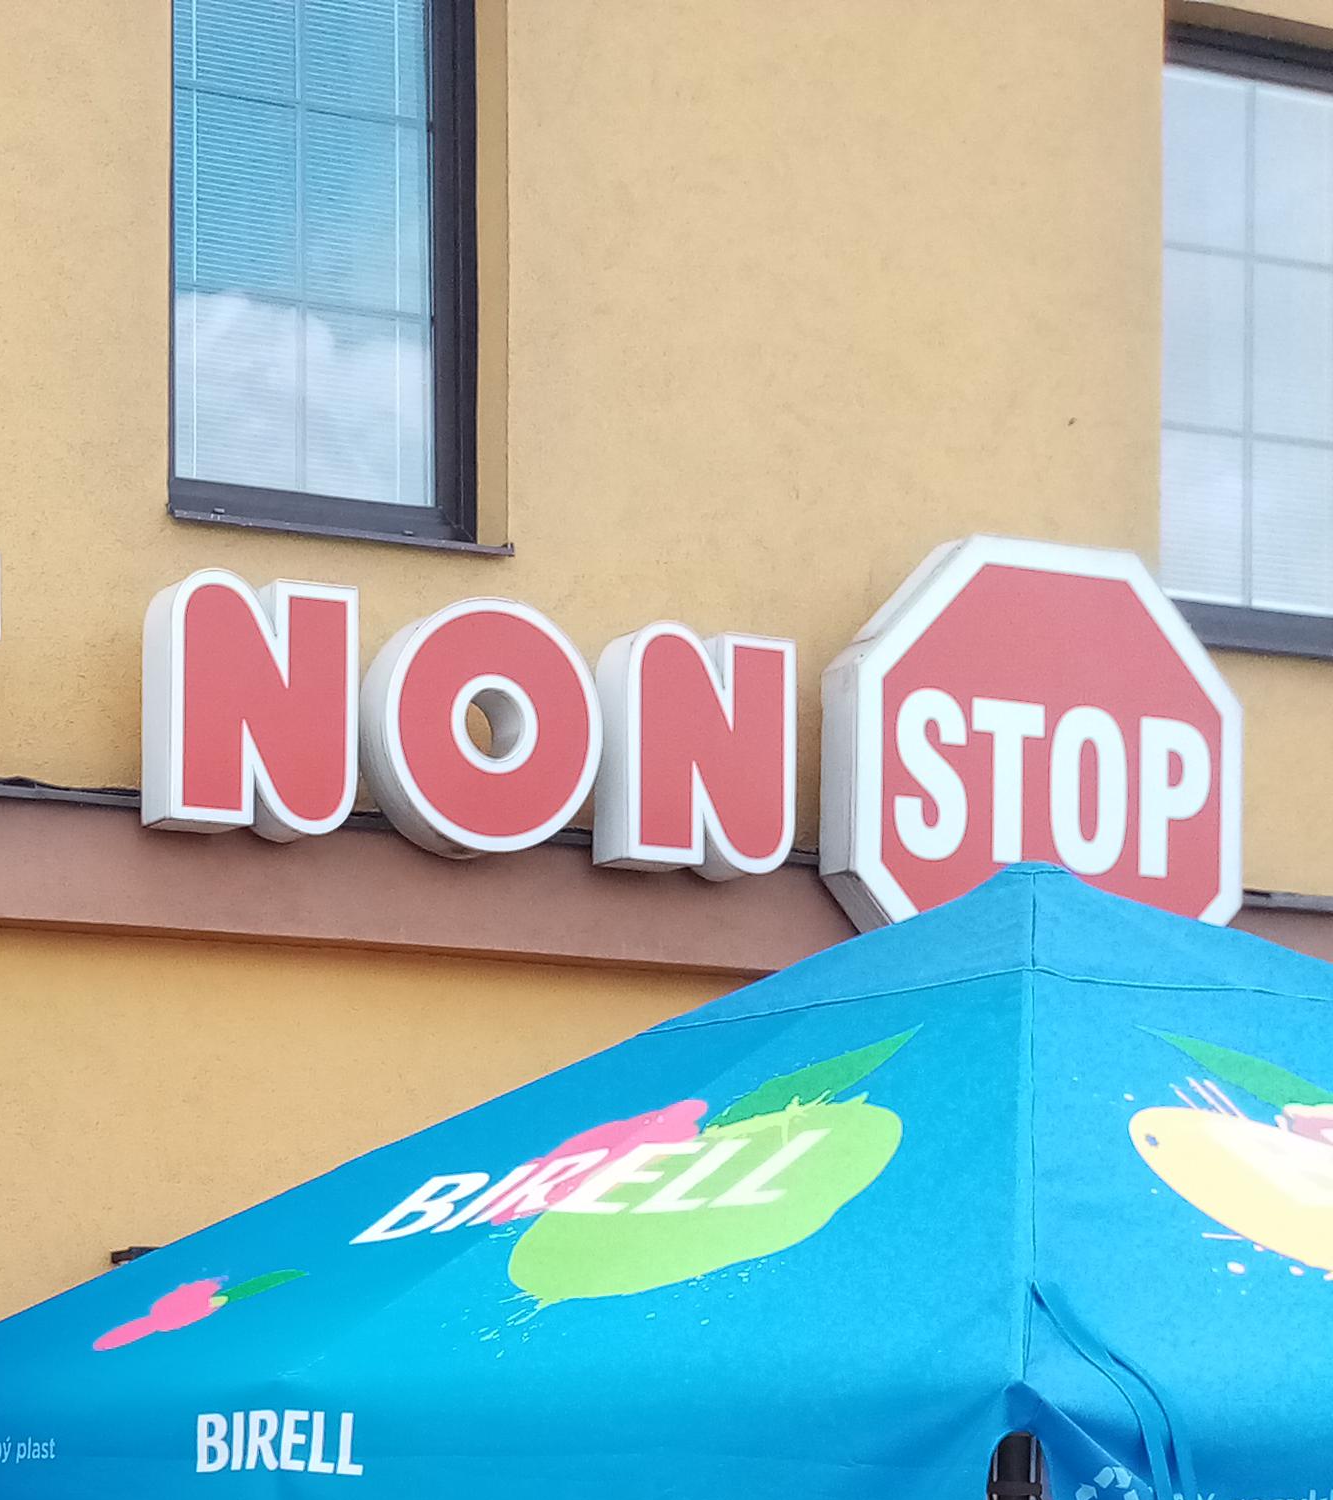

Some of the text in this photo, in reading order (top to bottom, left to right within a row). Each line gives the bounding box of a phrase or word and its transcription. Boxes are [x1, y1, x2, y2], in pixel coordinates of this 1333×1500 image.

[142, 567, 798, 882] NON
[892, 686, 1213, 879] STOP
[348, 1127, 832, 1246] BIRELL
[16, 1436, 57, 1464] plast
[195, 1408, 365, 1477] BIRELL
